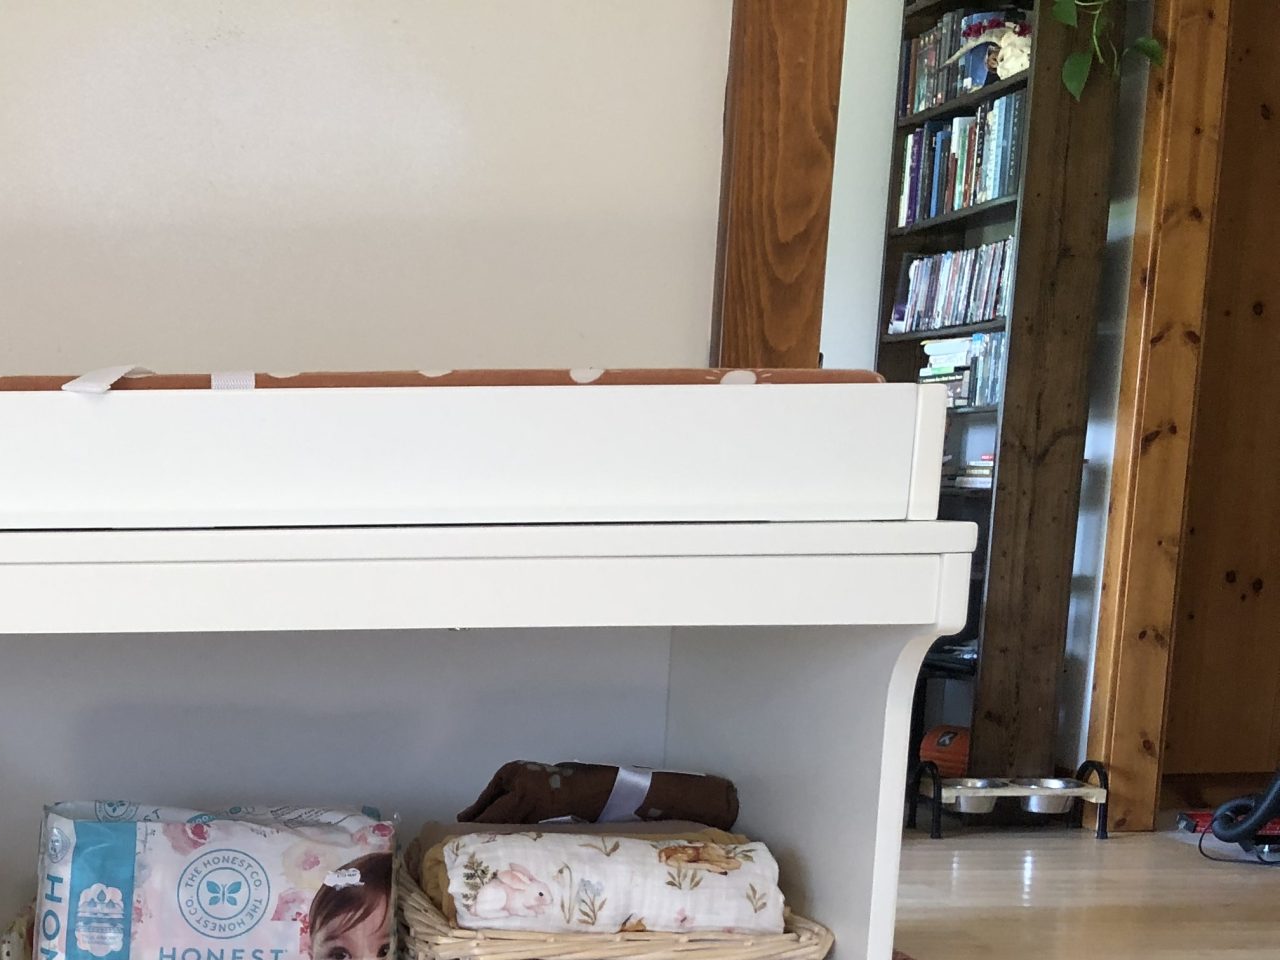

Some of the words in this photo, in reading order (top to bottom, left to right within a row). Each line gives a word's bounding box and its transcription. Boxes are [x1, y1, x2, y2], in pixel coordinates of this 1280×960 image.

[185, 867, 202, 888] THE
[202, 856, 254, 871] HONEST
[245, 898, 263, 920] THE
[195, 916, 246, 932] HONEST
